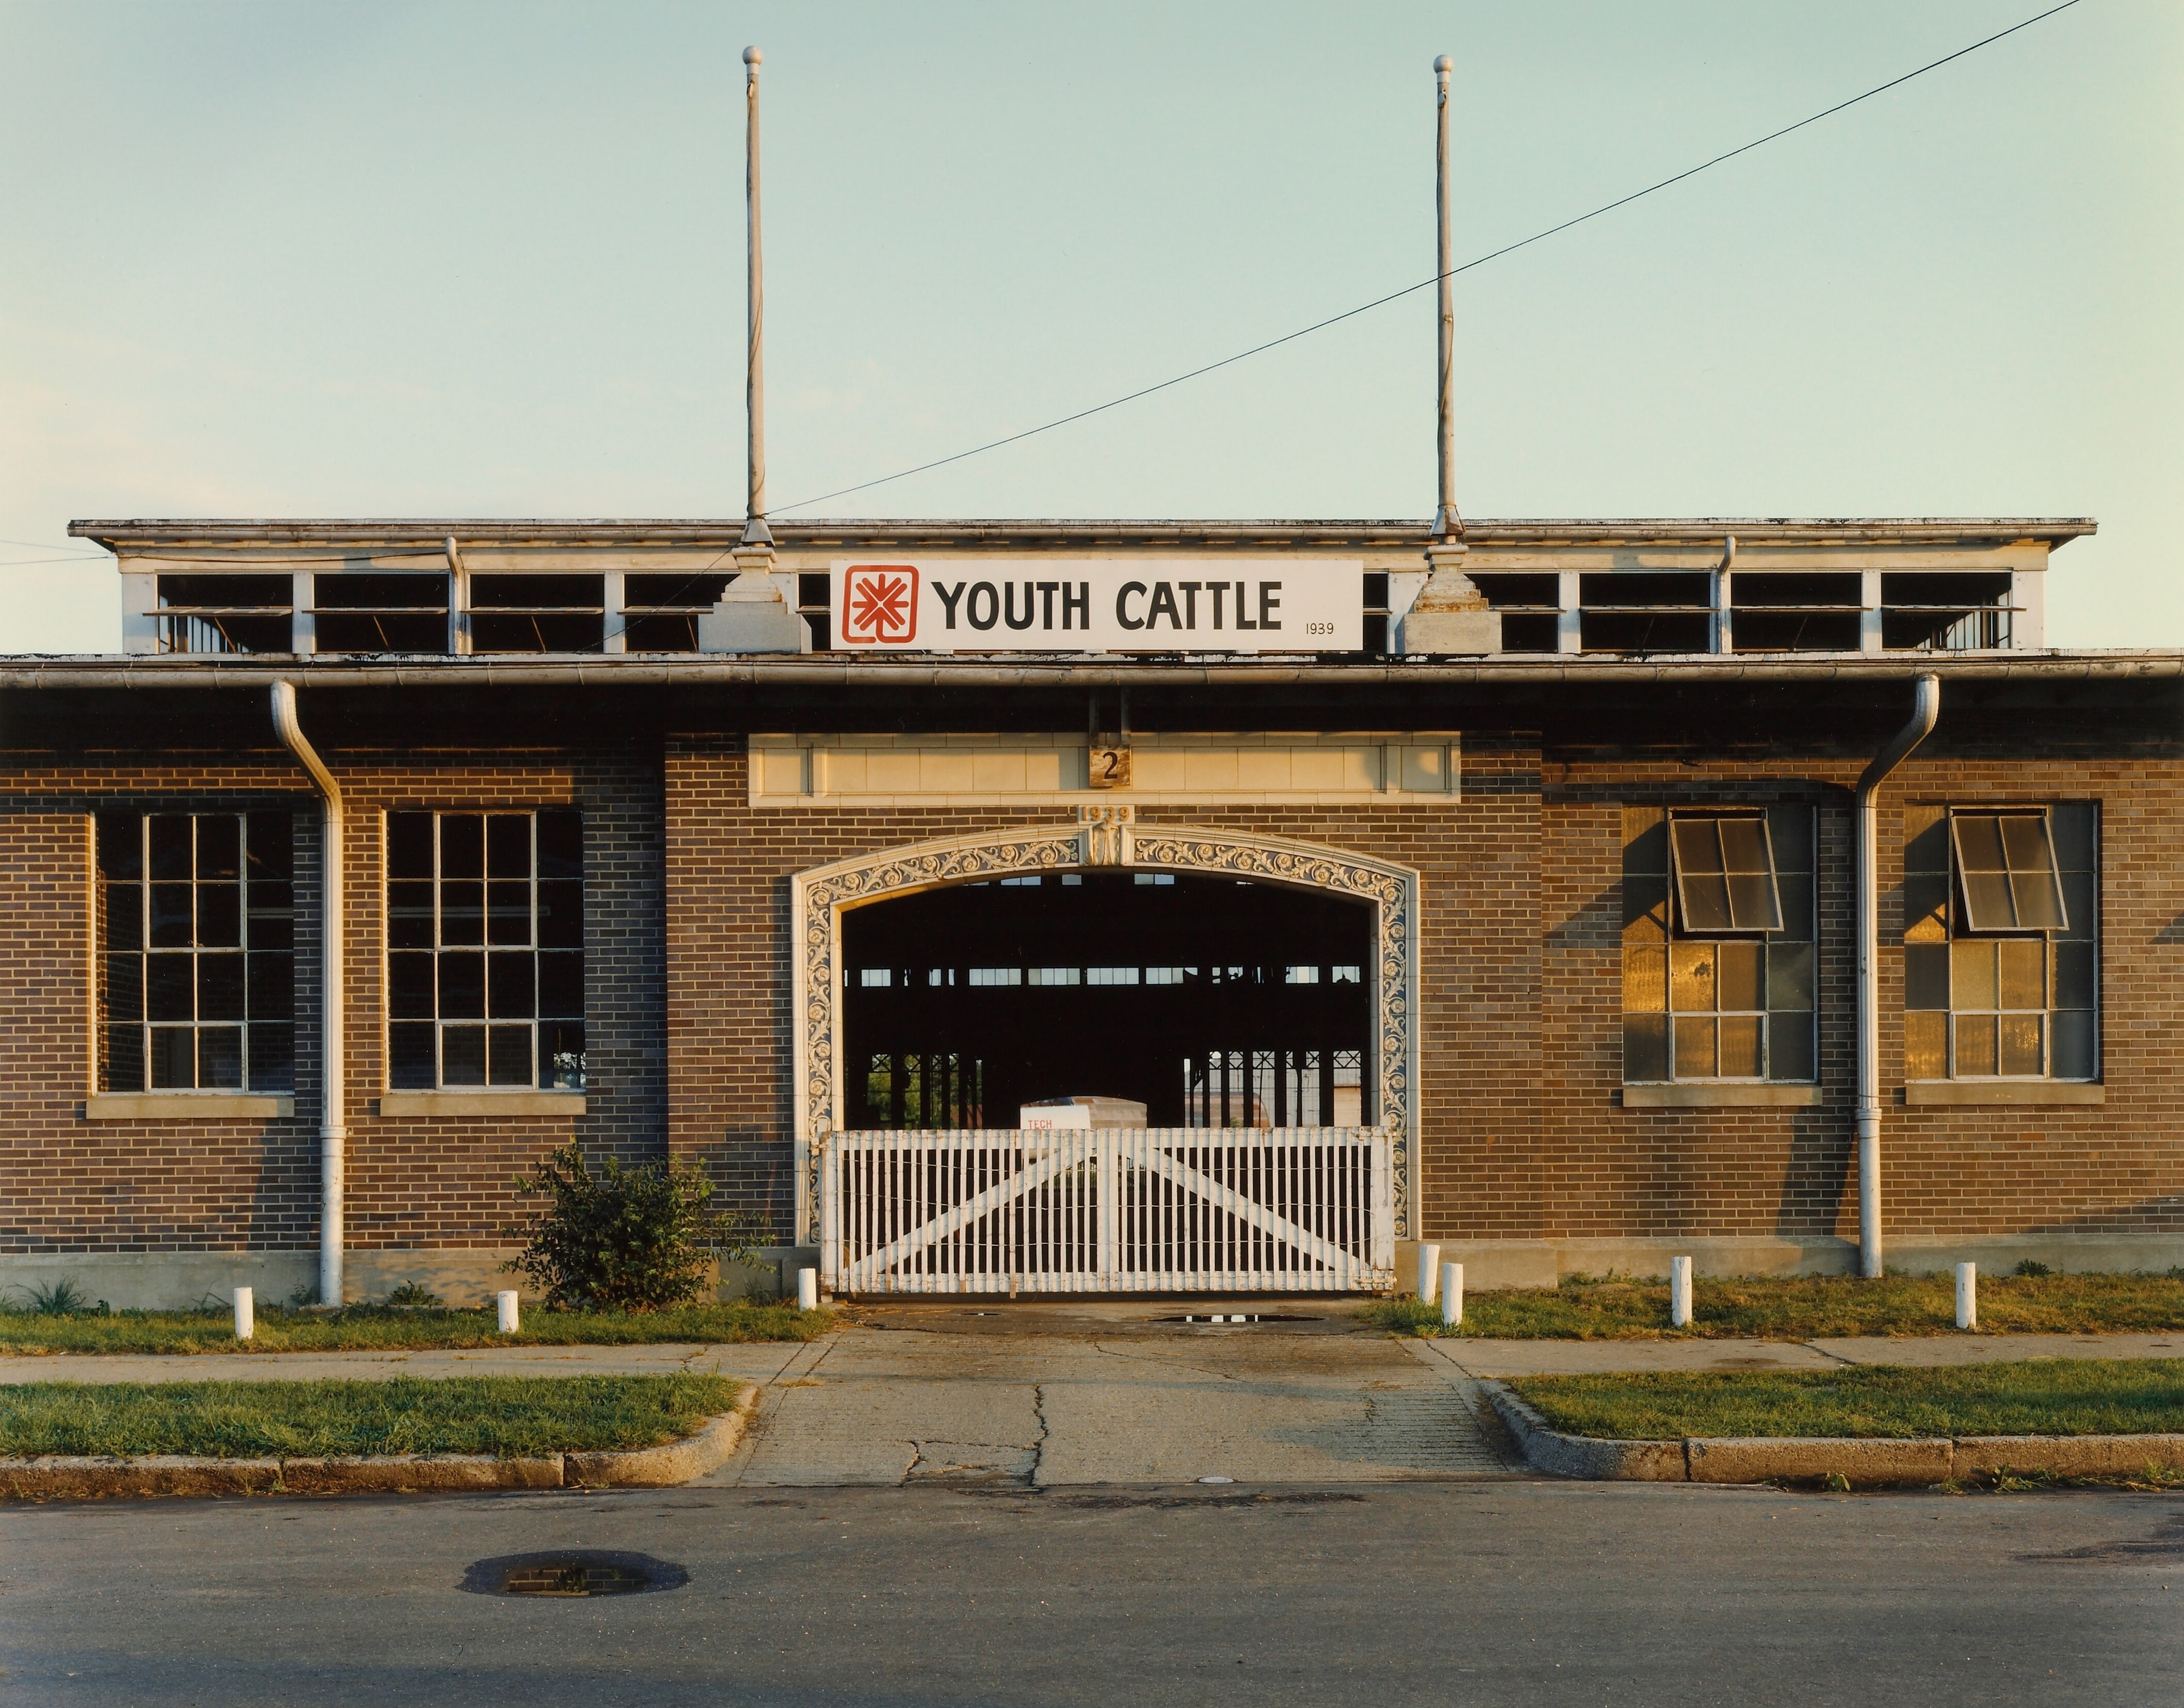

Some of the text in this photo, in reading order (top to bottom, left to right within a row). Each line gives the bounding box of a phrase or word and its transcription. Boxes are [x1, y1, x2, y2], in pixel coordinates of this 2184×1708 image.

[930, 581, 1282, 631] YOUTH CATTLE
[1305, 622, 1334, 635] 1939
[1102, 751, 1118, 780] 2
[1082, 806, 1130, 822] 1939
[1028, 1119, 1052, 1130] TECH
